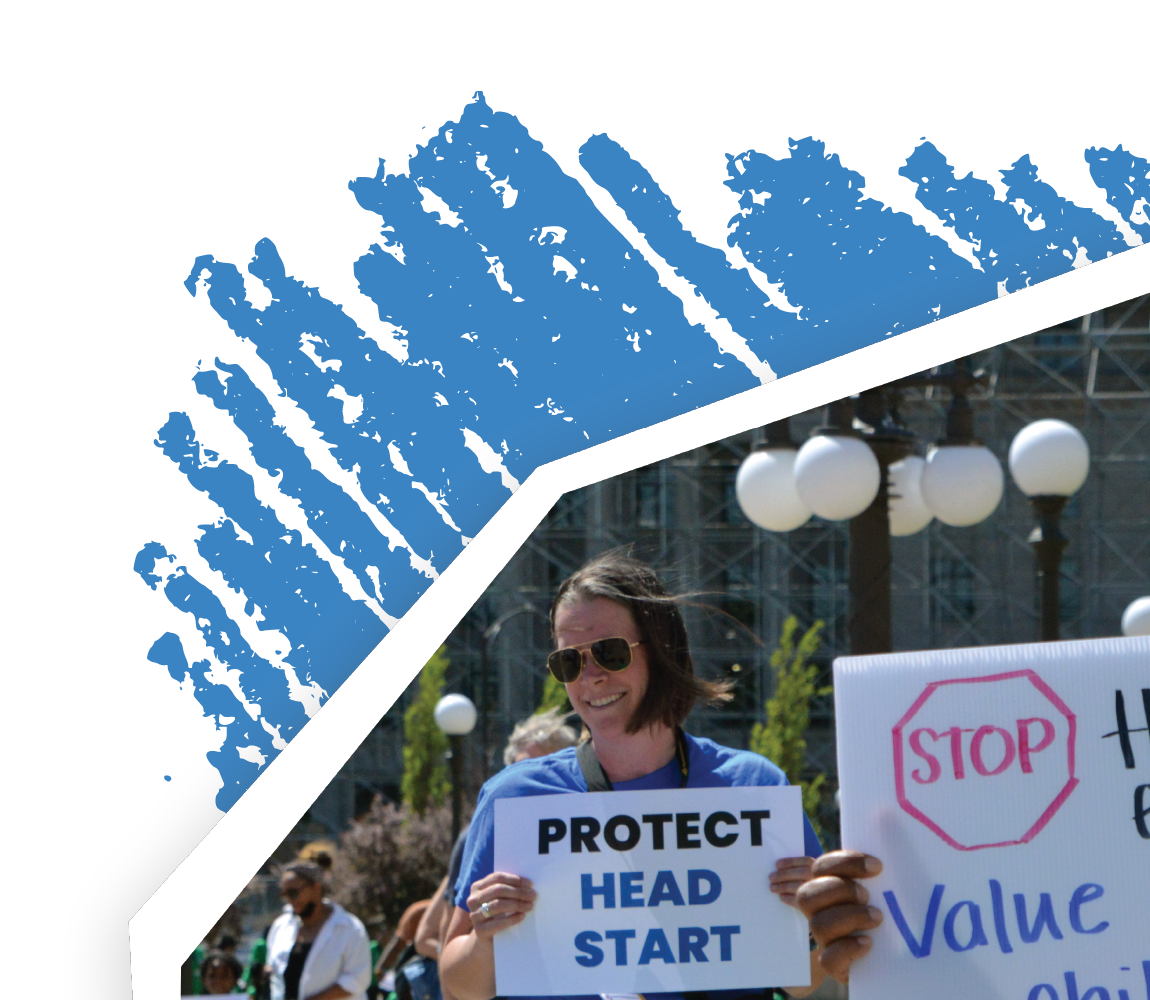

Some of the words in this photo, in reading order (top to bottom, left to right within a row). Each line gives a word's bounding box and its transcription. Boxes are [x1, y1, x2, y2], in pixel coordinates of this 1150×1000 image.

[909, 717, 1056, 784] STOP
[538, 810, 771, 855] PROTECT
[580, 868, 722, 910] HEAD
[883, 879, 1110, 959] Value
[574, 925, 741, 968] START
